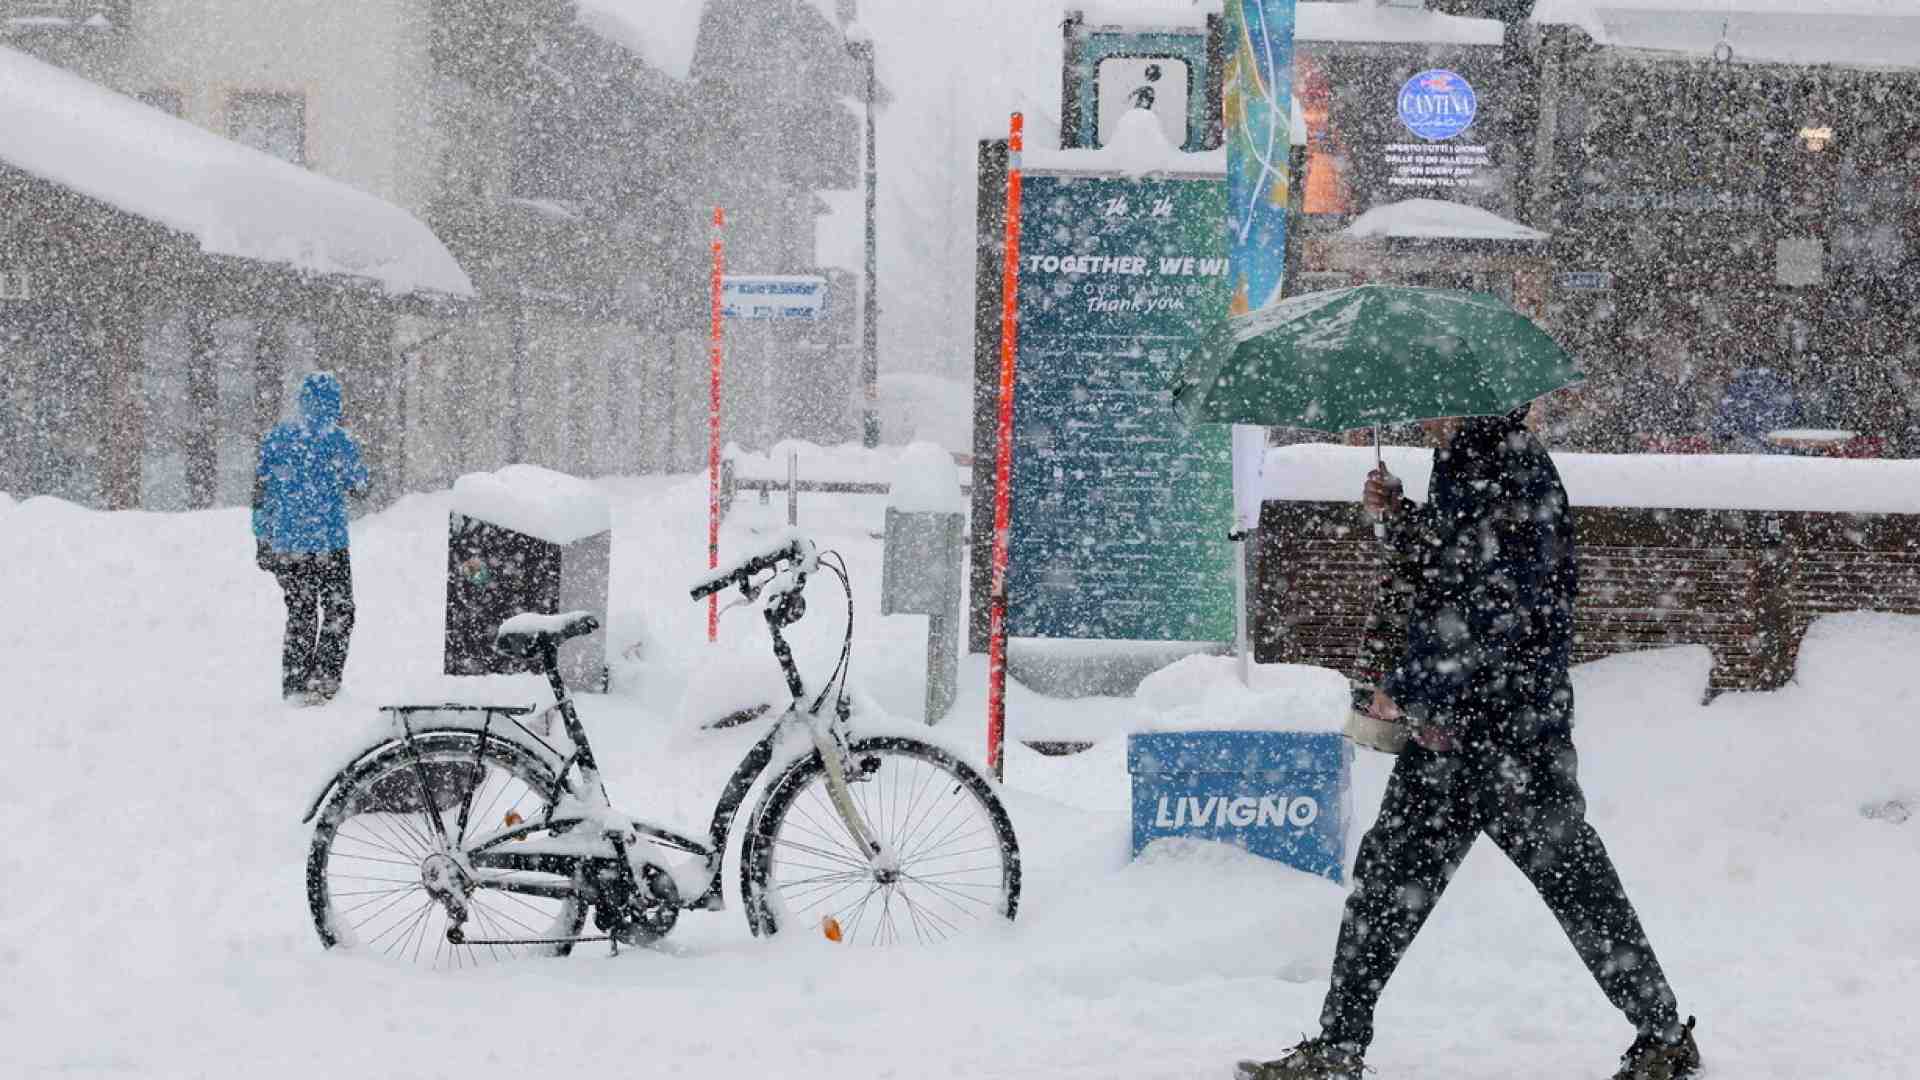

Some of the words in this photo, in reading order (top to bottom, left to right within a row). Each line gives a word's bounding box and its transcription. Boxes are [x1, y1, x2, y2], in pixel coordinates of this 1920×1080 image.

[1402, 93, 1470, 115] CANTINA
[1398, 166, 1424, 175] OPEN
[1030, 255, 1151, 277] TOGETHER,
[1159, 256, 1194, 276] WE
[1086, 297, 1140, 314] Thank
[1147, 298, 1185, 315] you
[1153, 795, 1318, 829] LIVIGNO
